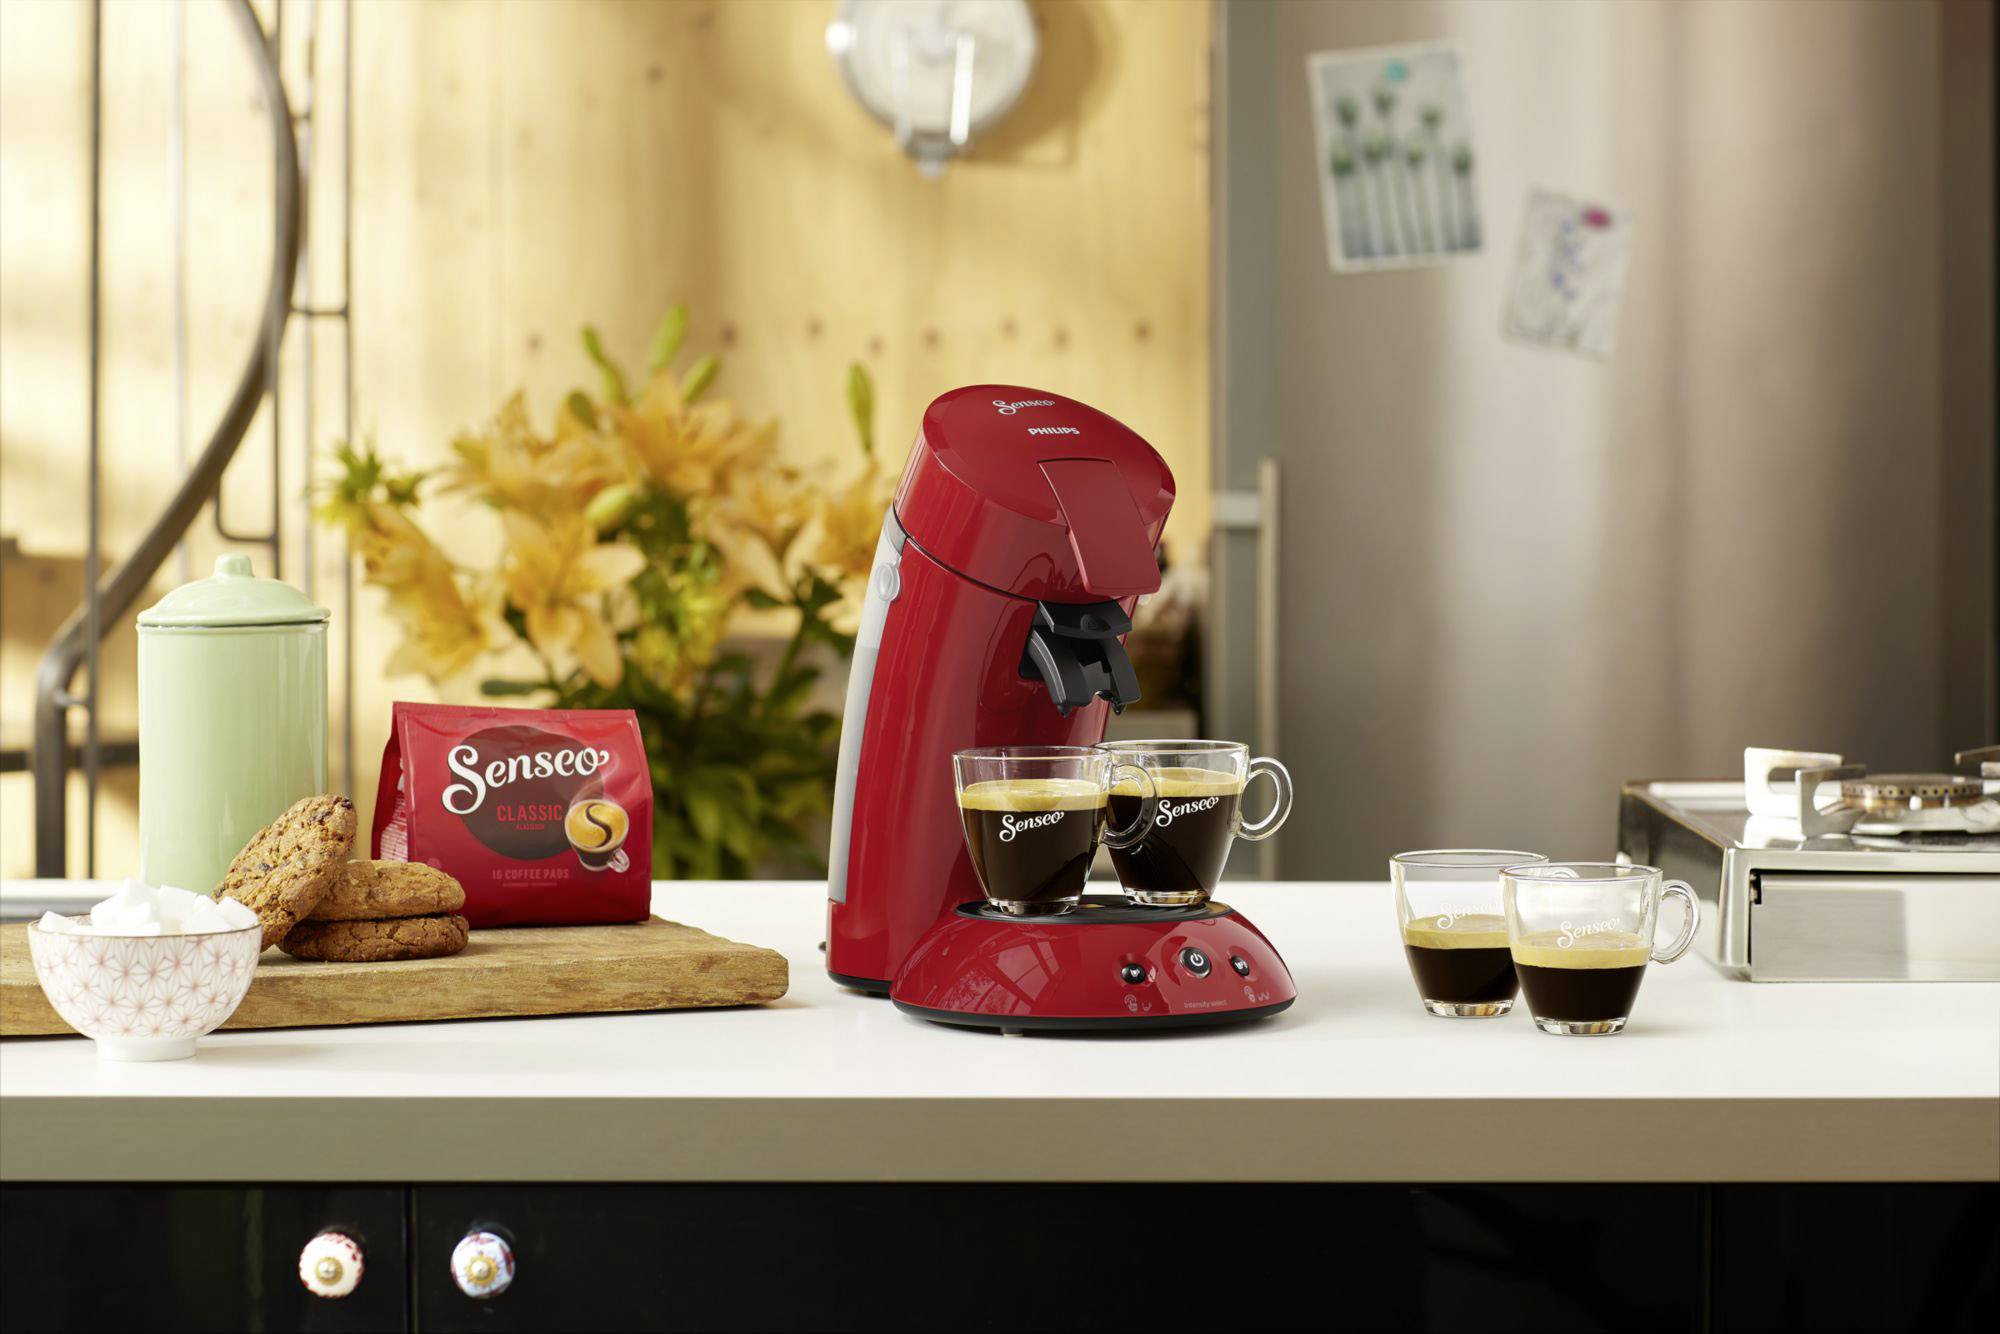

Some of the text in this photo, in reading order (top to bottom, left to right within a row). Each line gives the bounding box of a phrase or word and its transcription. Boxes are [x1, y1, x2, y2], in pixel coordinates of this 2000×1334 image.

[992, 400, 1055, 415] Senseo
[1027, 427, 1080, 435] PHILIPS
[442, 744, 610, 815] Senseo
[496, 804, 563, 822] CLASSIC
[1156, 796, 1219, 827] Senseo
[999, 811, 1064, 842] Senseo
[505, 869, 541, 880] COFFEE
[543, 868, 569, 879] PADS
[1557, 919, 1620, 949] Senseo
